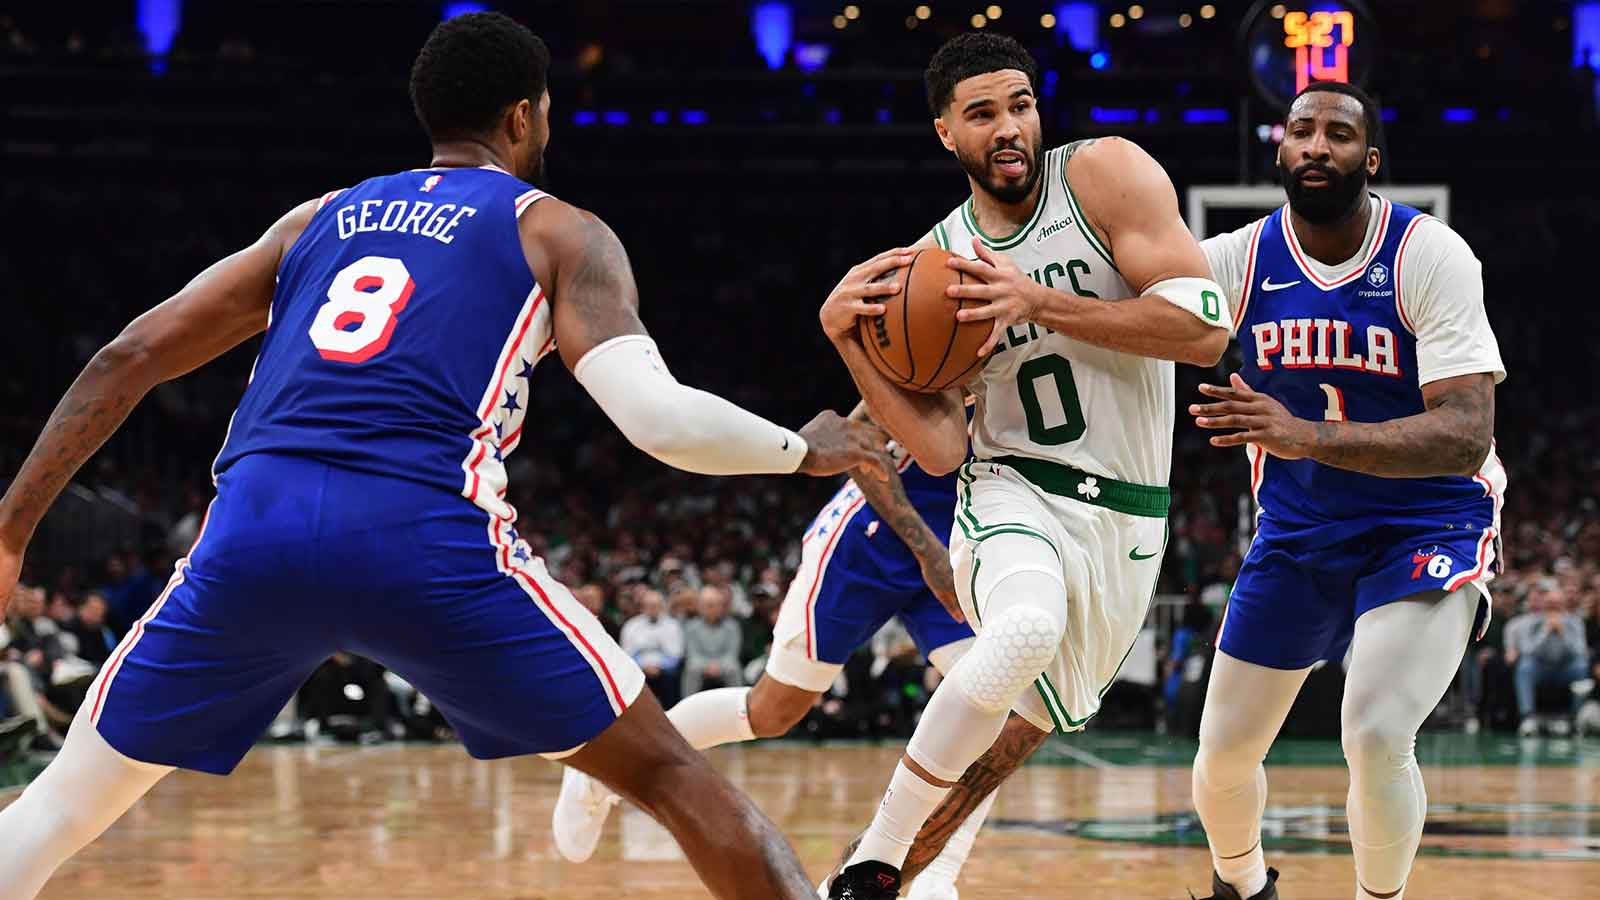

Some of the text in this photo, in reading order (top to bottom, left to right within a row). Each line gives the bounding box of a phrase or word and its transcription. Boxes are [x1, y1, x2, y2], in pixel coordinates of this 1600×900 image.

[1295, 43, 1349, 96] 14
[337, 199, 477, 244] GEORGE
[1036, 216, 1073, 242] Amica
[308, 256, 416, 364] 8
[1252, 318, 1403, 379] PHILA
[1016, 353, 1087, 446] 0
[1319, 383, 1348, 423] 1
[1411, 553, 1453, 580] 76
